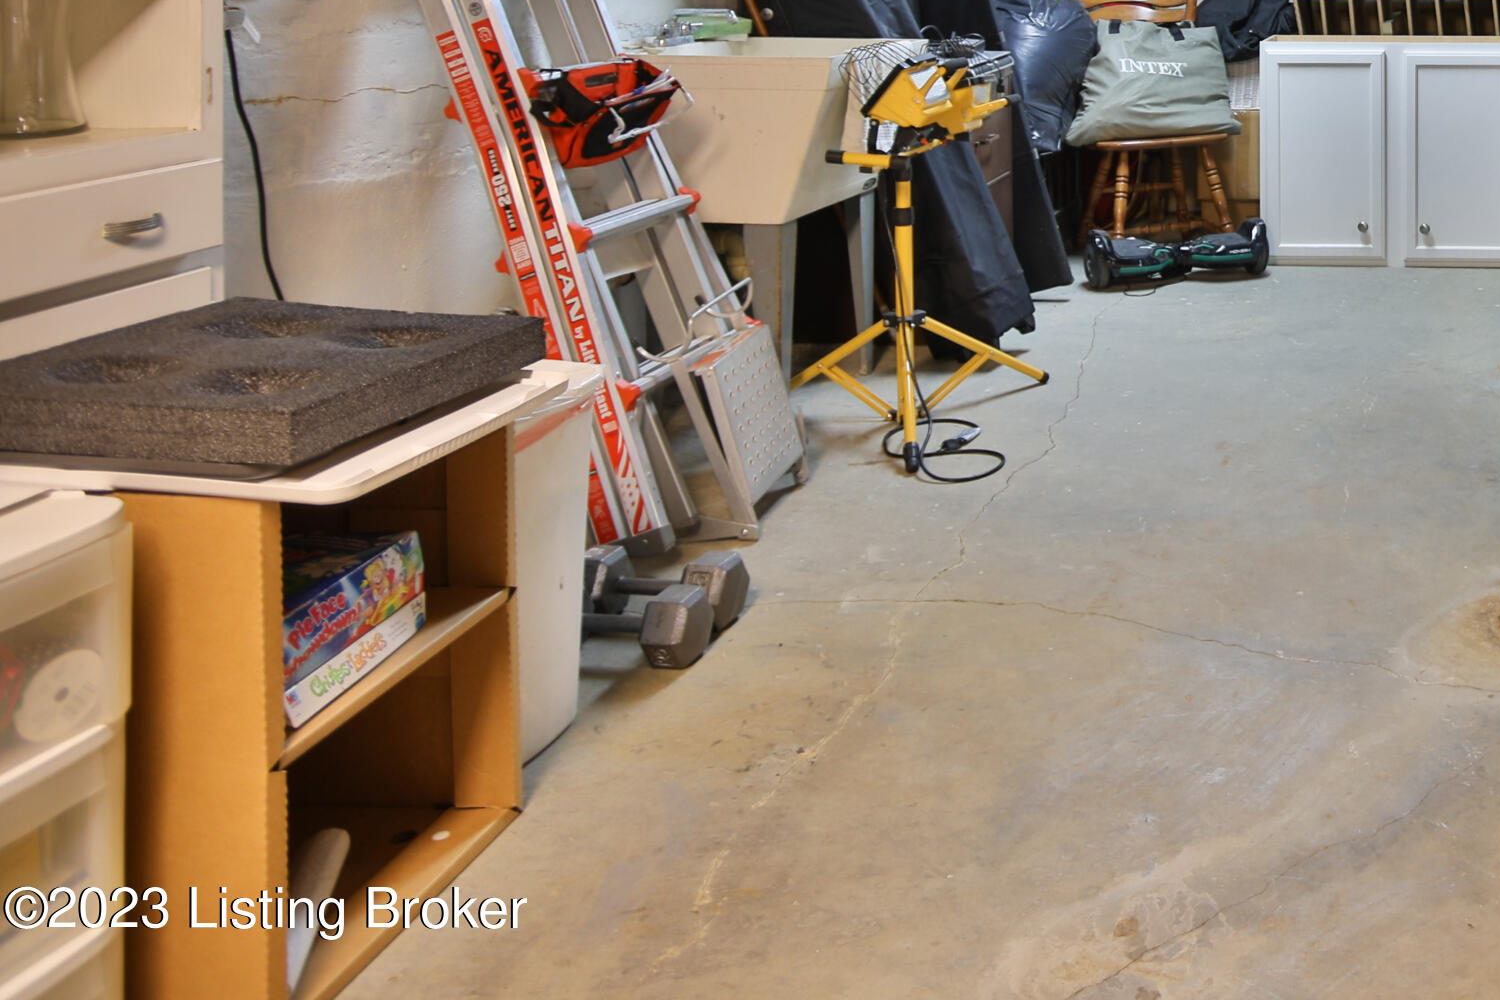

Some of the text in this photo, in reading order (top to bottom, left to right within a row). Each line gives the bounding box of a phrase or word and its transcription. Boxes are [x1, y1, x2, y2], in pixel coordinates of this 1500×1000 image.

[1119, 57, 1184, 78] INTEX
[492, 172, 513, 208] 250
[486, 50, 554, 223] AMERICAN
[544, 221, 585, 322] TITAN
[574, 326, 584, 339] by
[579, 339, 597, 364] Litt
[594, 384, 612, 419] iant
[287, 592, 347, 650] Pie Face
